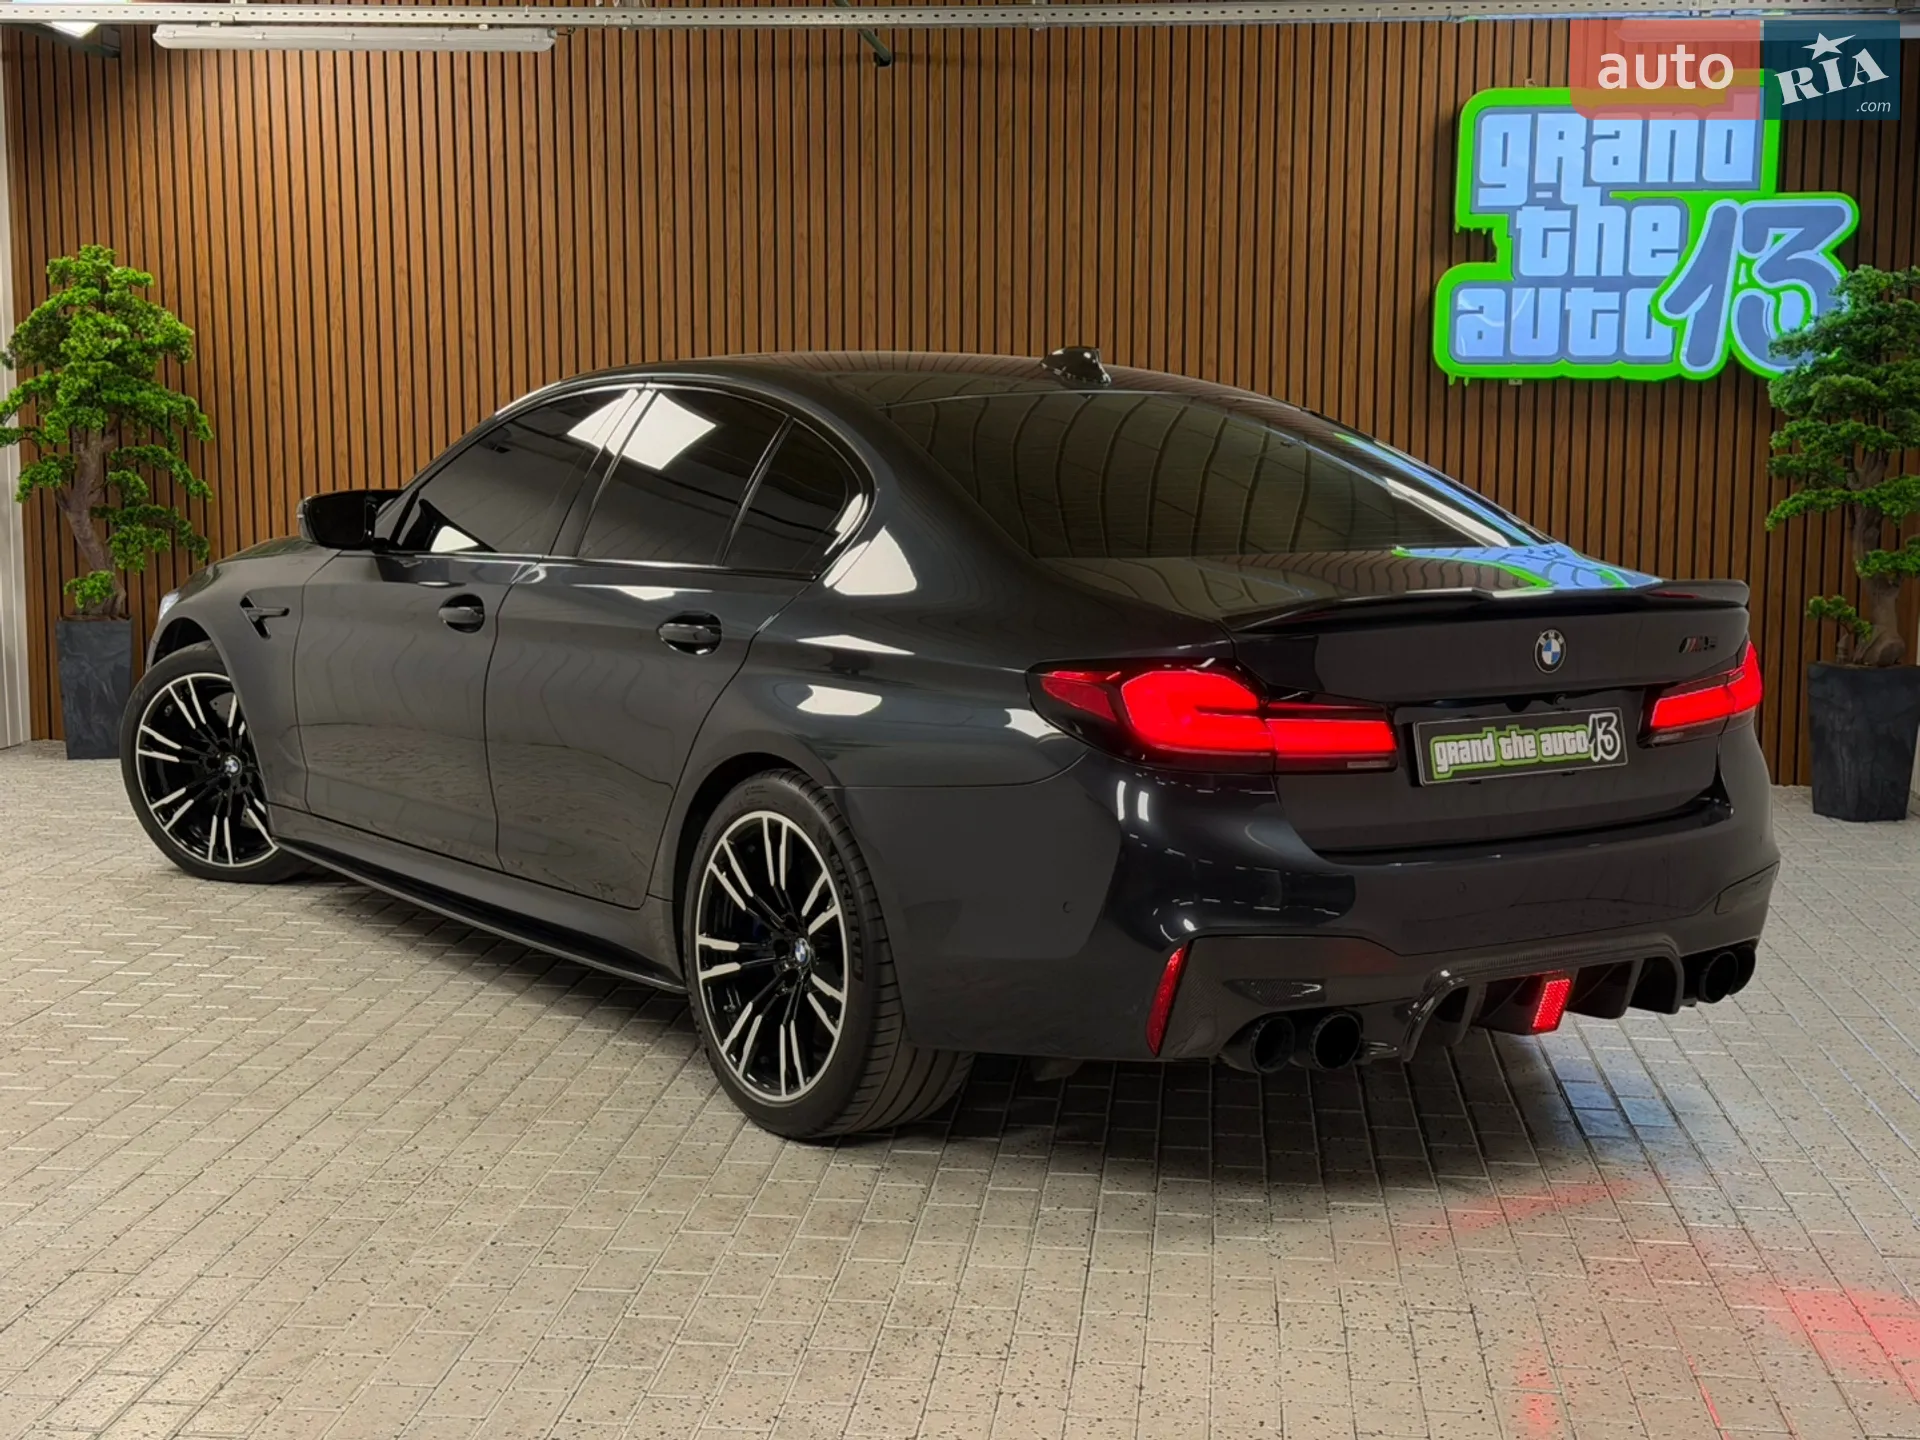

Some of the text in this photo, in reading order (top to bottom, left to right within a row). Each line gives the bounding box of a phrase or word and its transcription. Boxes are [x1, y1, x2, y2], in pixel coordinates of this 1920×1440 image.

[1478, 92, 1761, 208] grand
[1516, 187, 1683, 278] the
[1455, 287, 1674, 358] auto
[1658, 198, 1851, 374] 13
[1434, 712, 1621, 774] grand the auto 13
[829, 852, 865, 984] MICH
